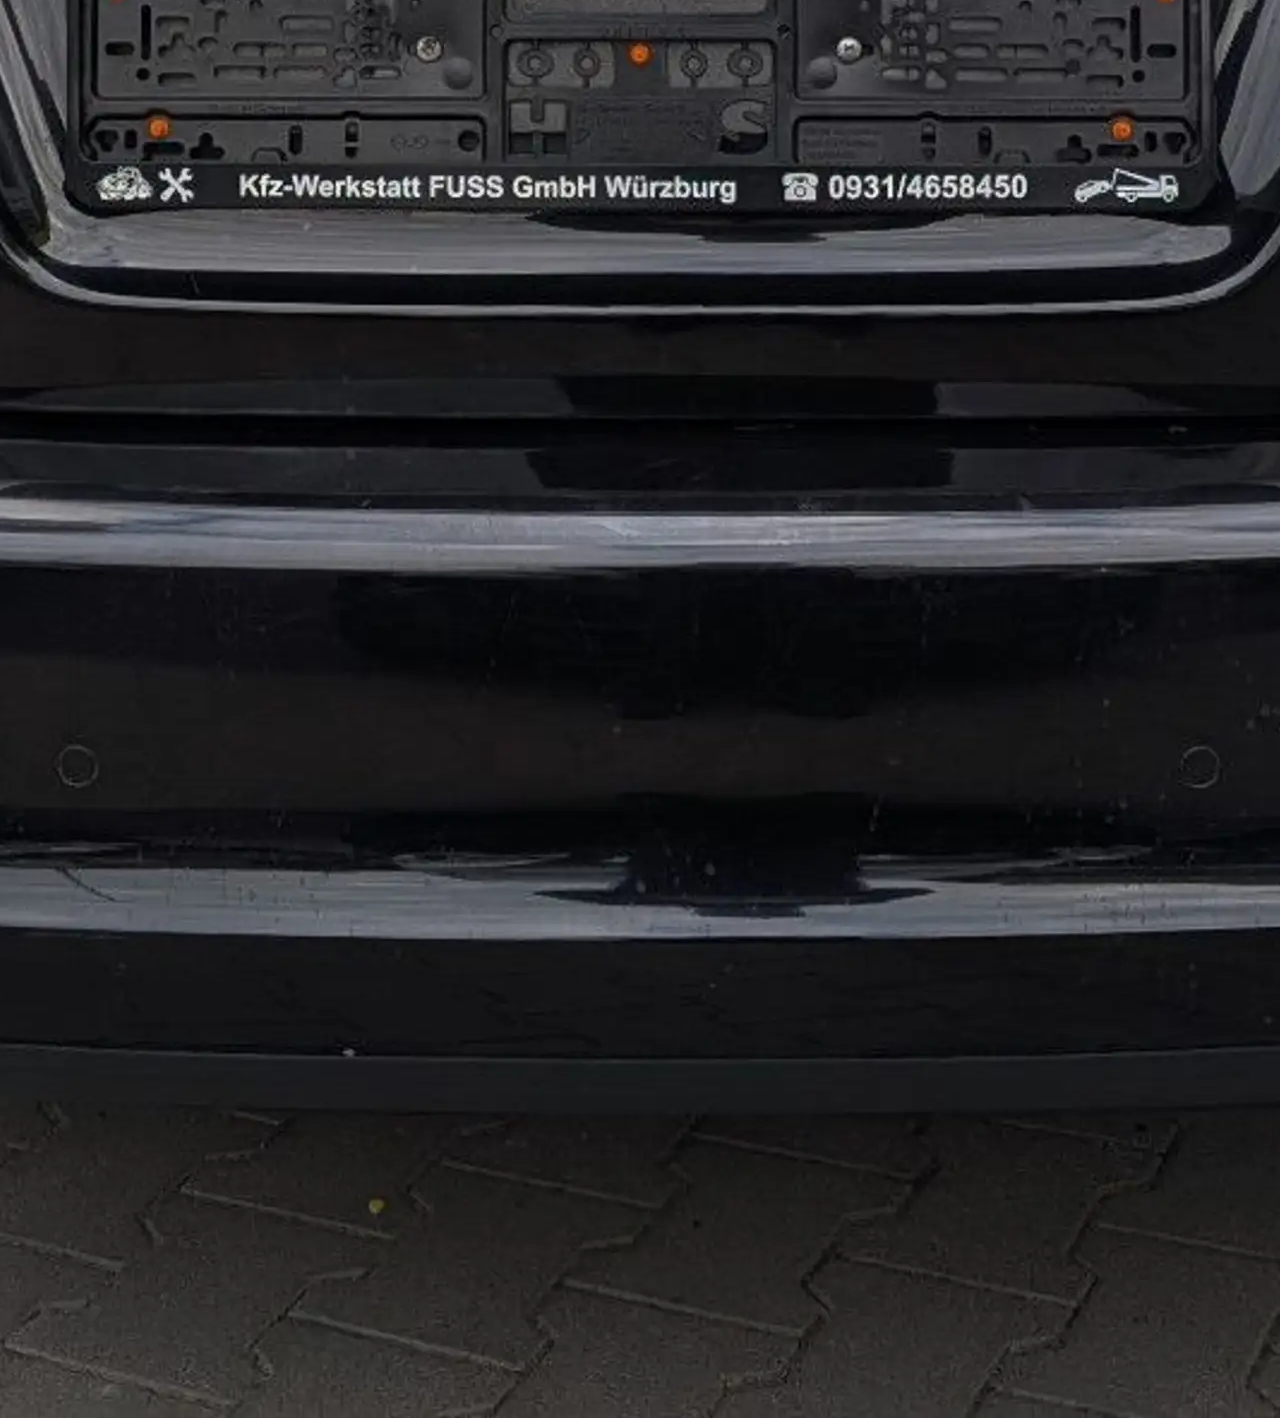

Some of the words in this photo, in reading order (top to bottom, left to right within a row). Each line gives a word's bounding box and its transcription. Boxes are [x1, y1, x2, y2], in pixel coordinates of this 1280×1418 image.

[239, 174, 420, 198] Kfz-Werkstatt
[429, 174, 504, 198] FUSS
[513, 174, 596, 198] GmbH
[605, 174, 737, 203] Würzburg
[828, 174, 1029, 200] 0931/4658450
